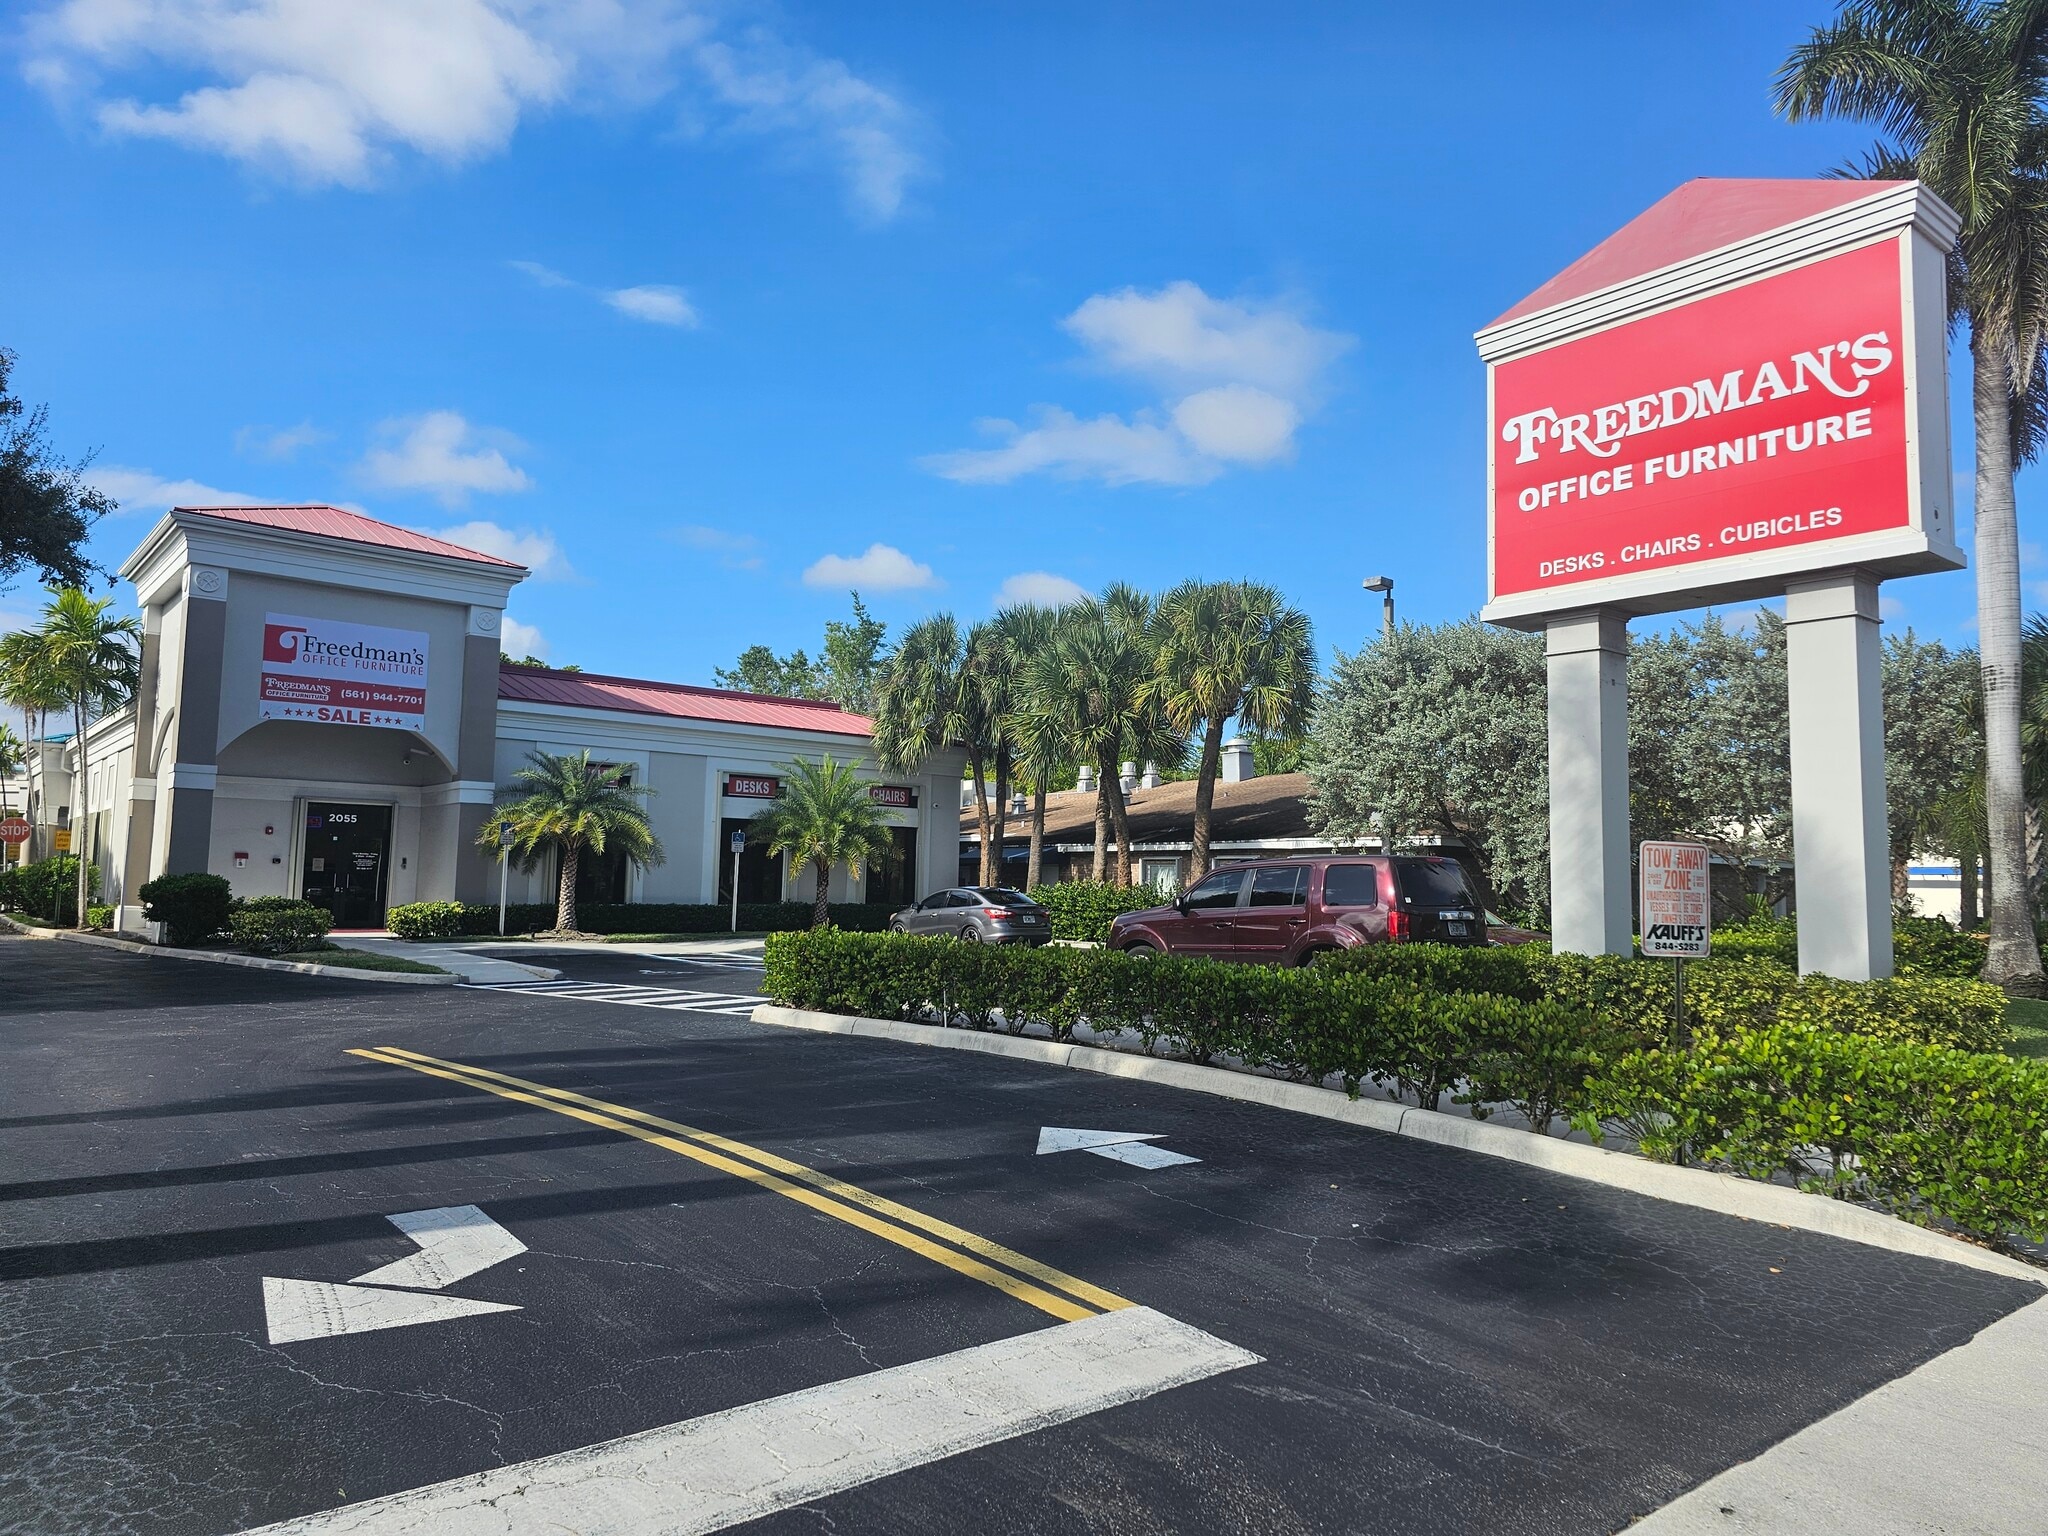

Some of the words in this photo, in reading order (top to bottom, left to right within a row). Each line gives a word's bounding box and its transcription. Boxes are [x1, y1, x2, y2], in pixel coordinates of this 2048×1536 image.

[1502, 331, 1893, 464] FREEDMAN'S
[1518, 464, 1633, 512] OFFICE
[1645, 408, 1872, 484] FURNITURE
[1539, 552, 1604, 577] DESKS
[1620, 534, 1700, 563] CHAIRS
[1720, 507, 1842, 544] CUBICLES
[303, 635, 424, 666] Freedman's
[303, 653, 347, 667] OFFICE
[355, 659, 424, 676] FURNITURE
[265, 678, 331, 694] FREEDMAN'S
[267, 690, 291, 698] OFFICE
[292, 692, 328, 701] FURNITURE
[341, 689, 369, 700] (561)
[373, 692, 423, 705] 944-7701
[317, 707, 371, 725] SALE
[736, 780, 769, 794] DESKS
[873, 789, 906, 803] CHAIRS
[328, 814, 358, 823] 2055
[0, 825, 29, 836] STOP
[1646, 848, 1672, 868] TOW
[1676, 849, 1705, 870] AWAY
[1664, 869, 1692, 890] ZONE
[1646, 924, 1706, 941] KAUFF'S
[1655, 942, 1699, 951] 844-5283
